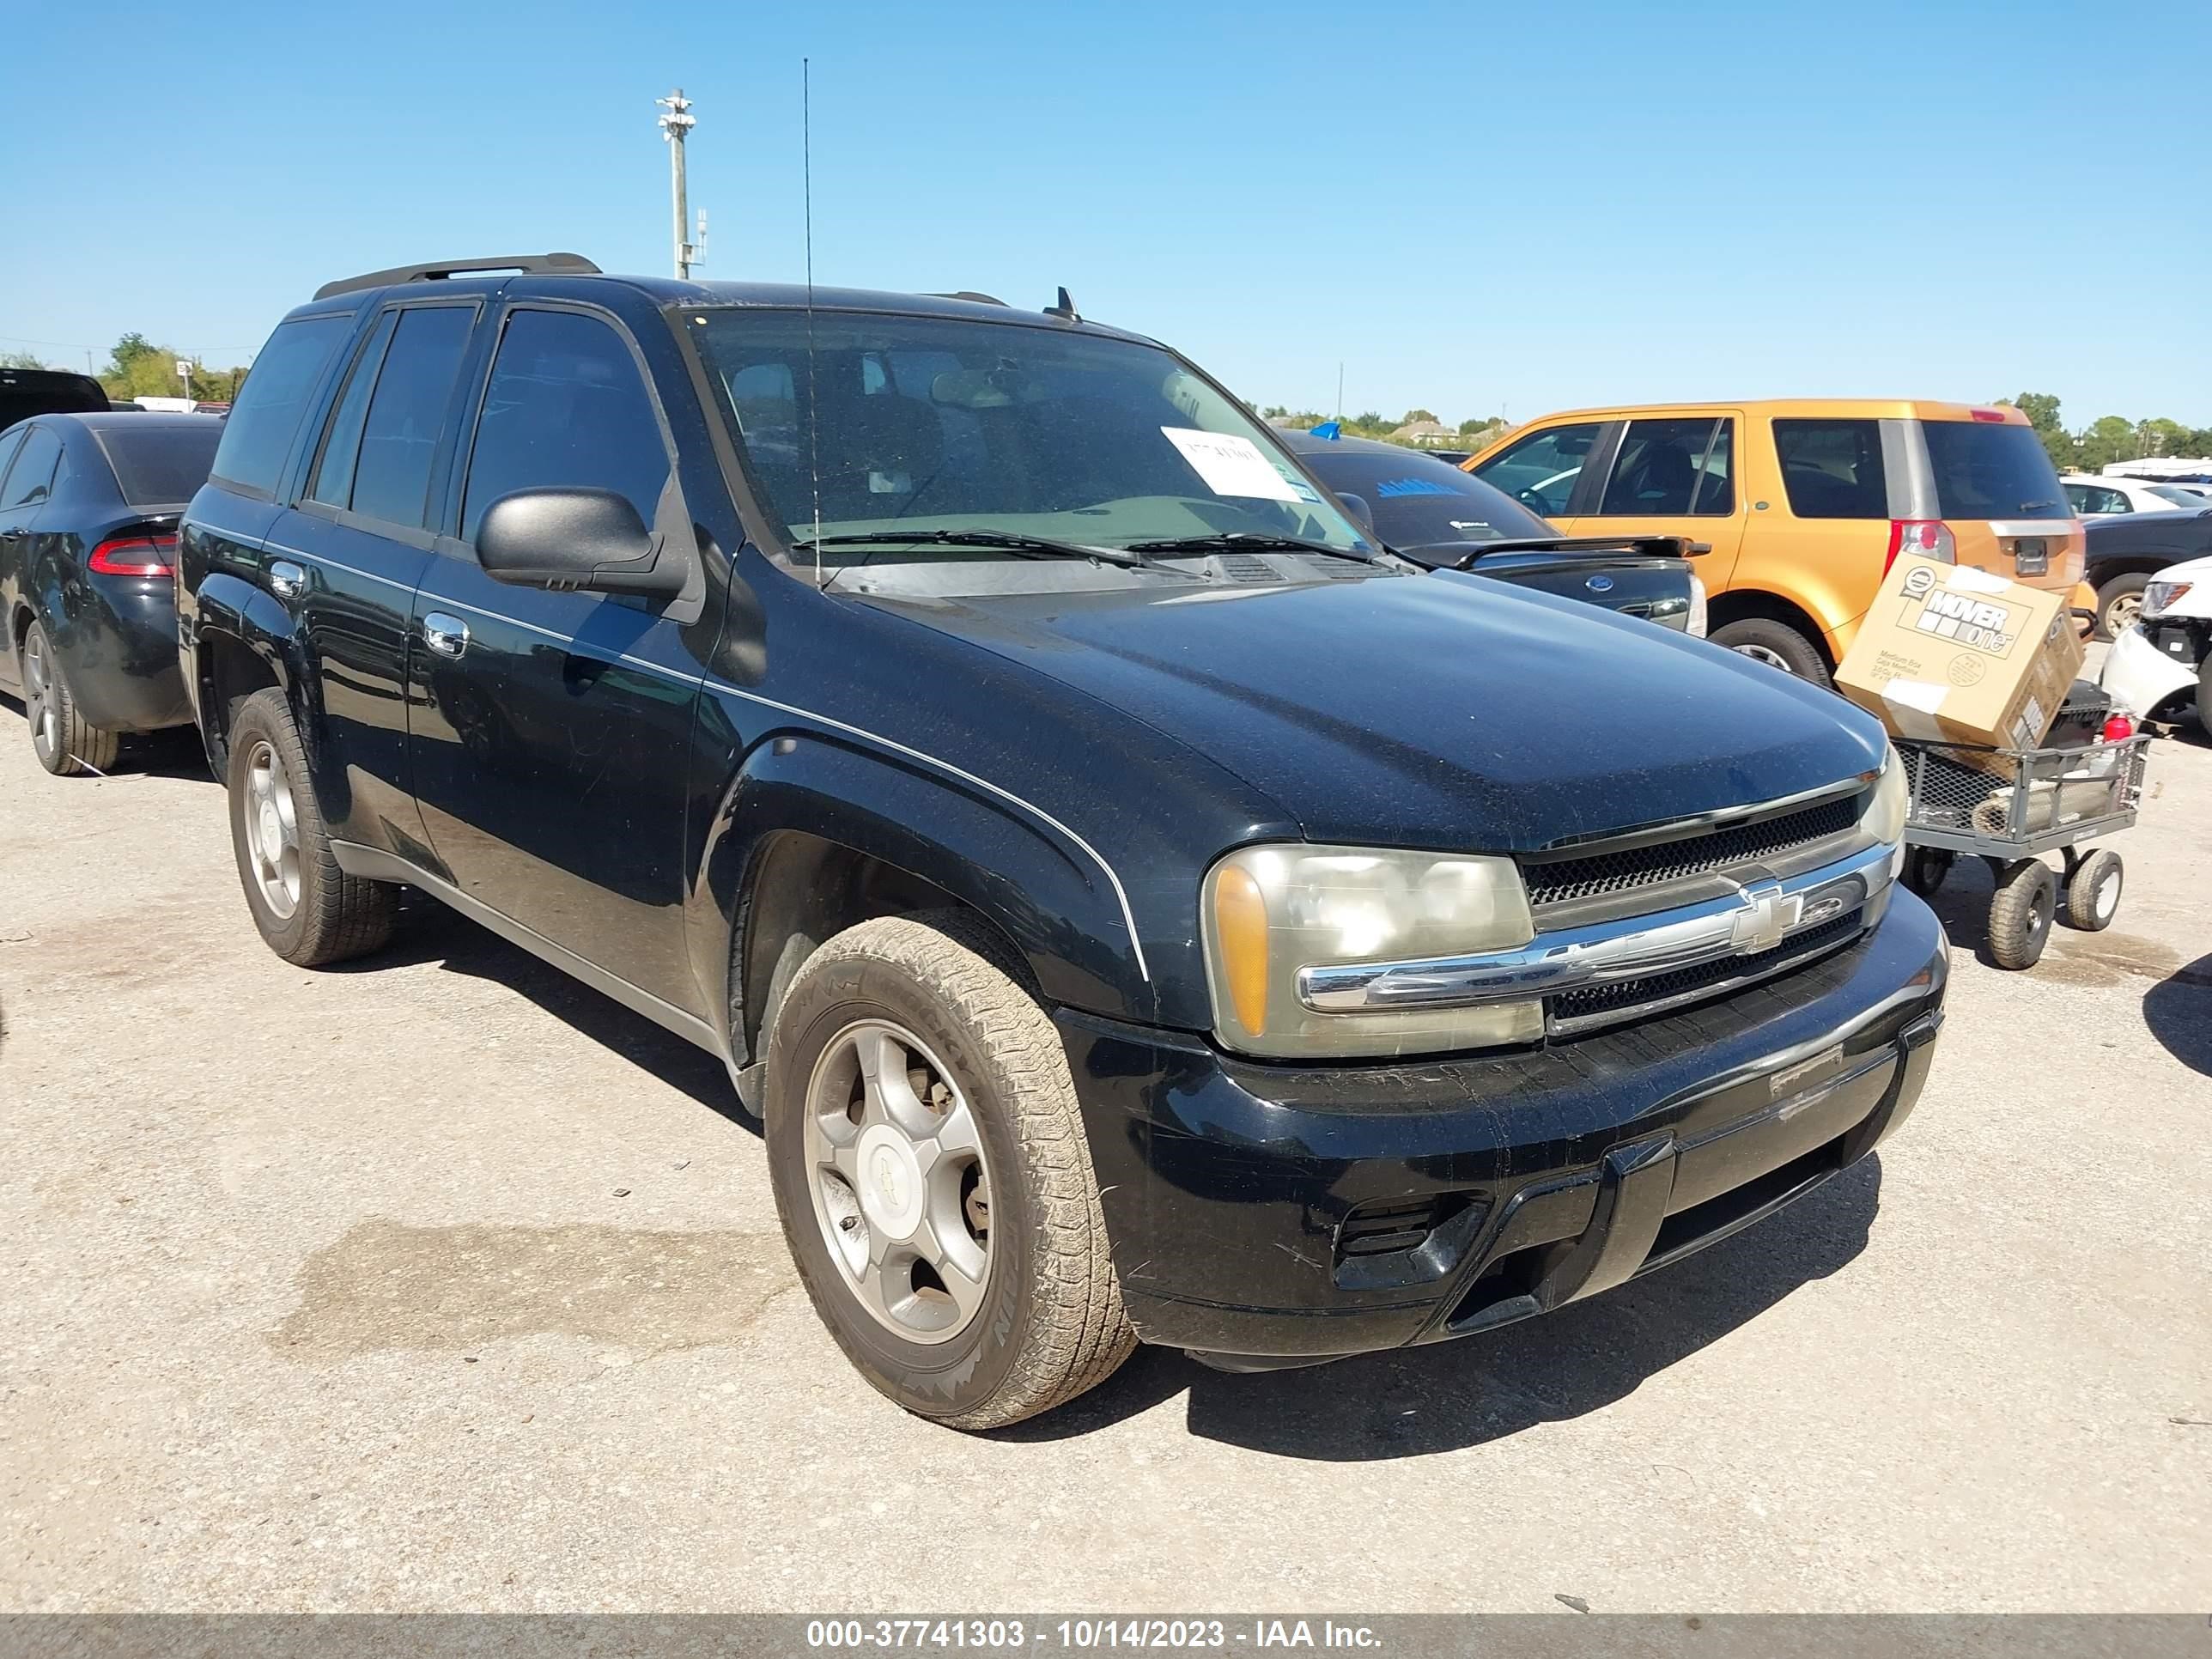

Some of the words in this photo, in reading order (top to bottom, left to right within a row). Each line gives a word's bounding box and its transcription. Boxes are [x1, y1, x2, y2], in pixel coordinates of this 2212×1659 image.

[1925, 589, 2009, 631] MOVER
[1966, 626, 2007, 652] one
[1880, 650, 1908, 664] Medium
[1908, 659, 1922, 669] Box
